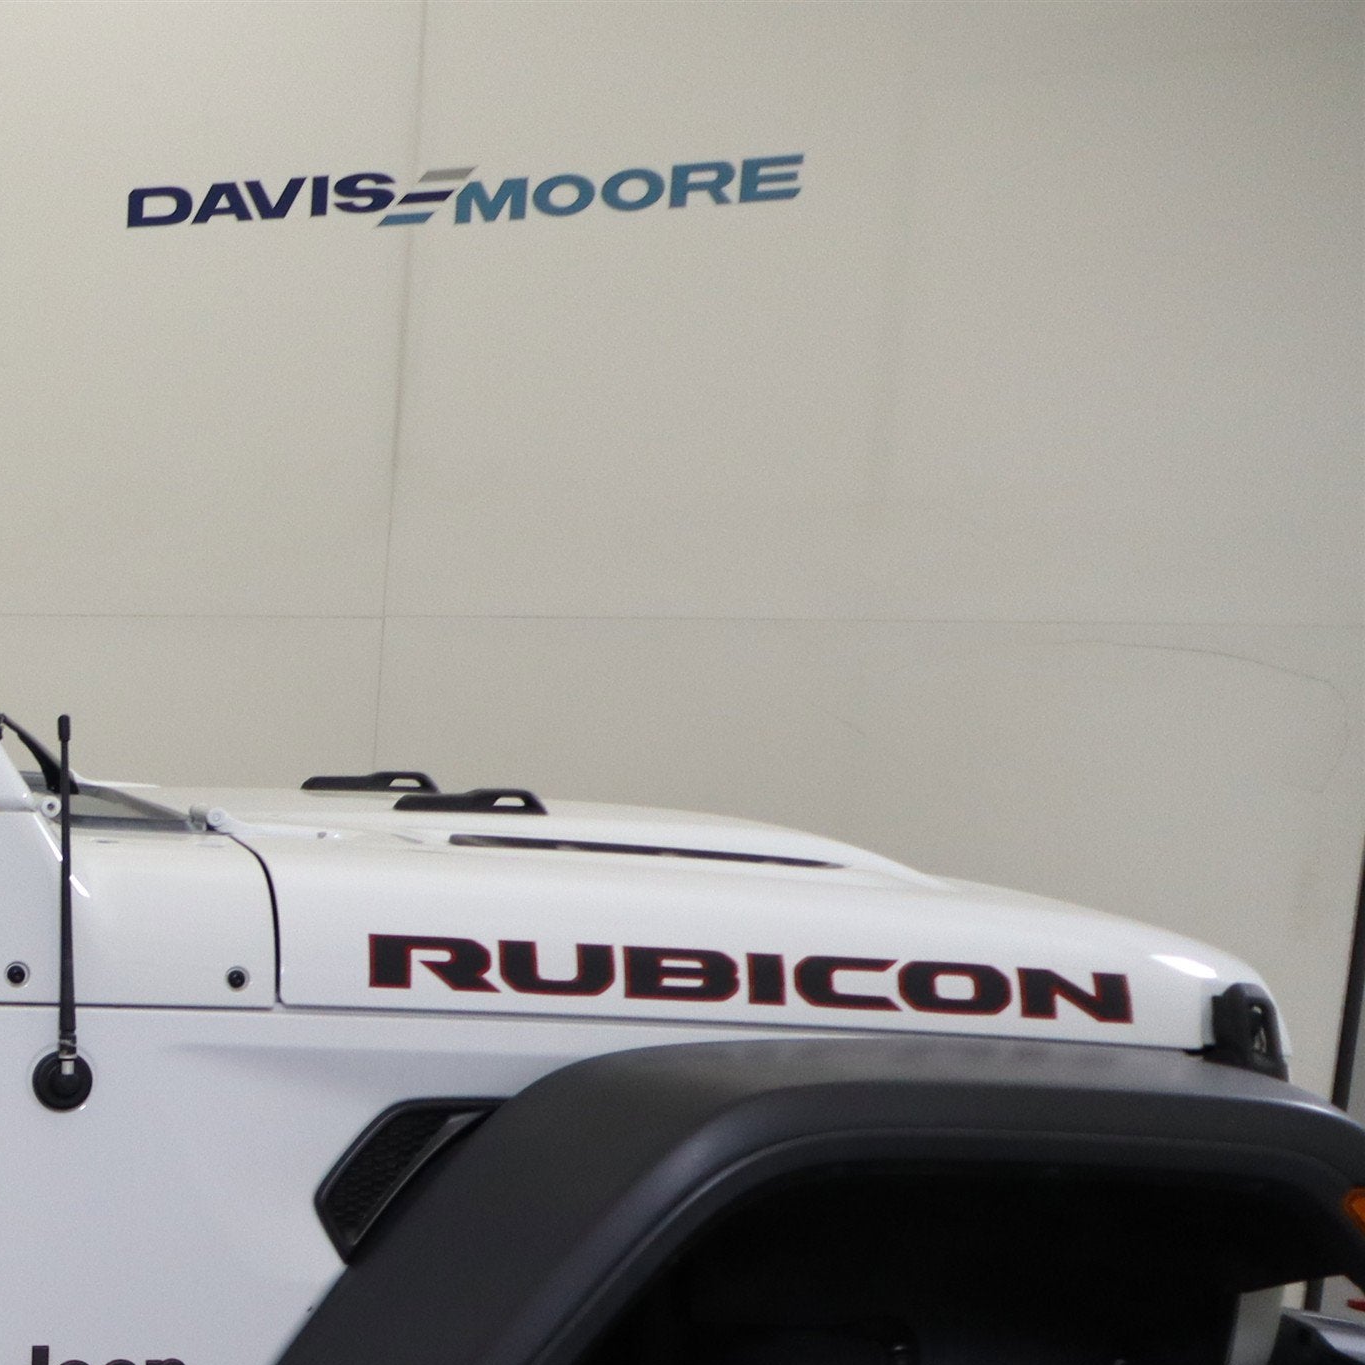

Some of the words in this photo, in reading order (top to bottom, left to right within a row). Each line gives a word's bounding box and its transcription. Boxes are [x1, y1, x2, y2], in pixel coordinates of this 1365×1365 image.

[126, 171, 396, 229] DAVIS
[454, 154, 804, 224] MOORE
[368, 933, 1135, 1025] RUBICON
